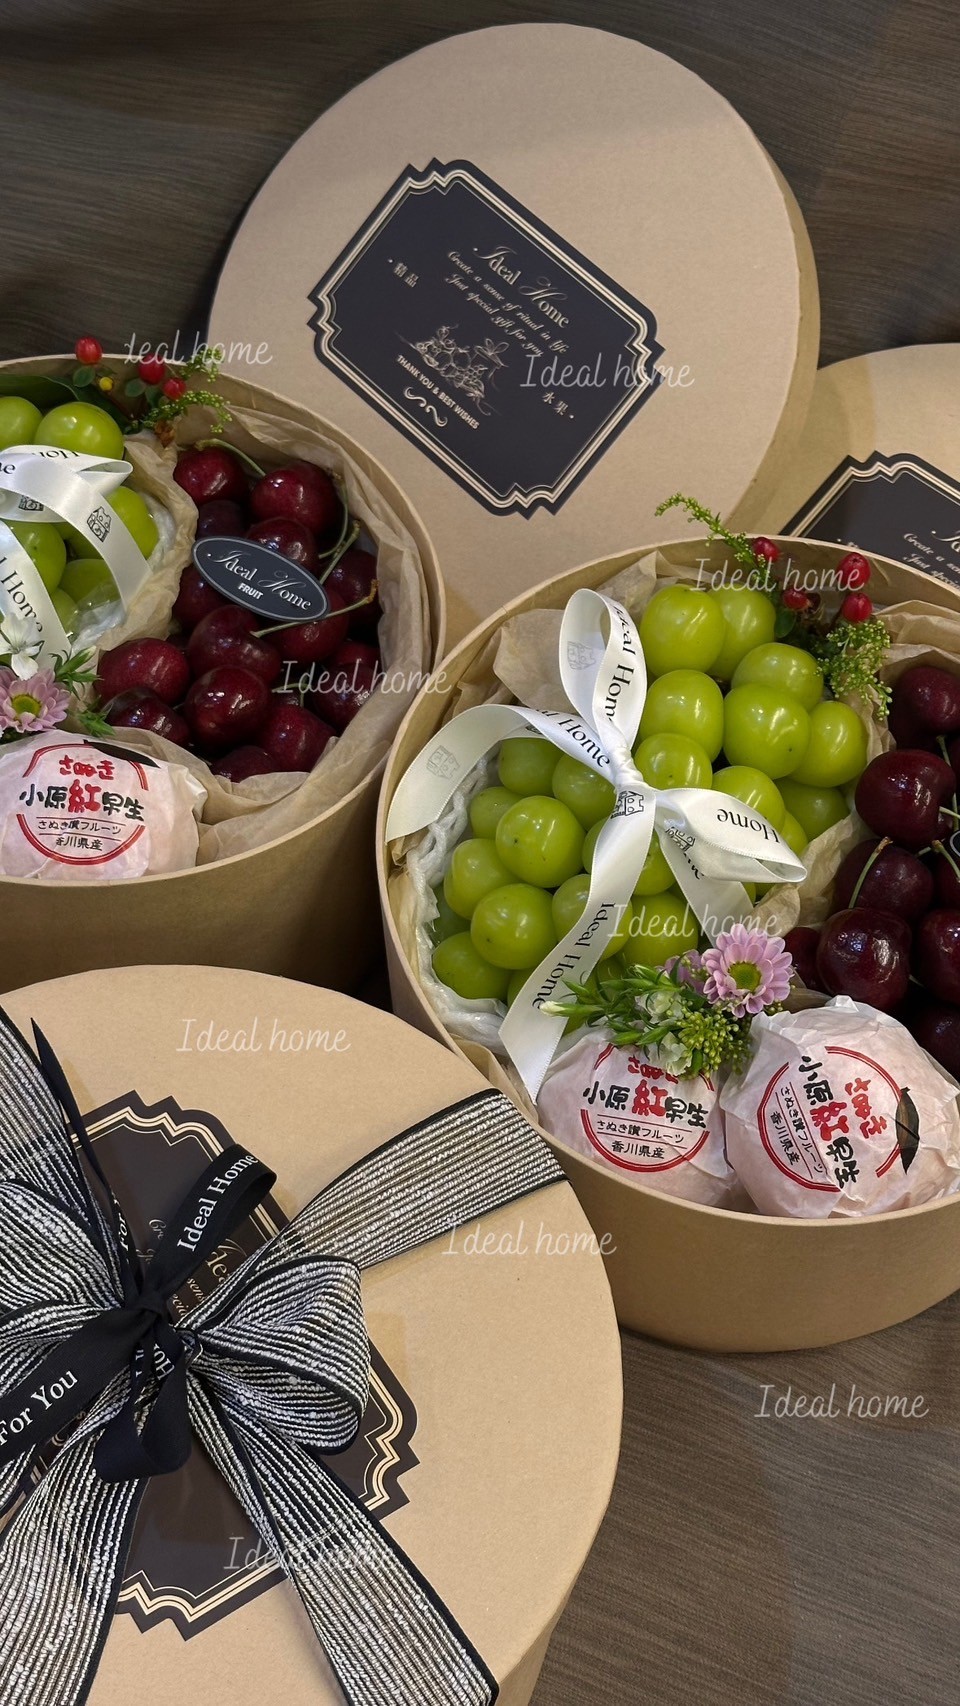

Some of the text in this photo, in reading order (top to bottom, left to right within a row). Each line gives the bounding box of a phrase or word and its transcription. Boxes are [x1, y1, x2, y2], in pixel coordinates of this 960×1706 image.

[444, 273, 469, 292] Just
[466, 292, 500, 315] special
[491, 316, 516, 329] gift
[504, 328, 527, 342] for
[448, 251, 474, 275] Create
[483, 283, 505, 300] sense
[502, 302, 522, 312] of
[516, 311, 545, 331] ritual
[540, 331, 551, 341] in
[549, 340, 570, 354] life
[473, 246, 569, 328] Ideal Home
[397, 354, 480, 430] THANK YOU & BEST WISHES
[902, 553, 931, 569] Just
[903, 533, 934, 555] Create
[207, 550, 311, 611] Ideal Home
[238, 582, 264, 600] FRUIT
[604, 664, 635, 722] Hom
[59, 755, 115, 781] さぬき
[558, 718, 610, 768] Home
[19, 779, 145, 822] 小原紅早生
[717, 808, 780, 843] Home
[574, 903, 616, 947] Ideal
[582, 1080, 709, 1129] 小原紅早生
[798, 1055, 860, 1189] 小原紅早生
[845, 1077, 887, 1139] さぬき
[611, 1140, 665, 1159] 香川県産
[770, 1110, 801, 1166] 香川県産
[177, 1154, 259, 1252] Ideal Home
[31, 1371, 78, 1410] You
